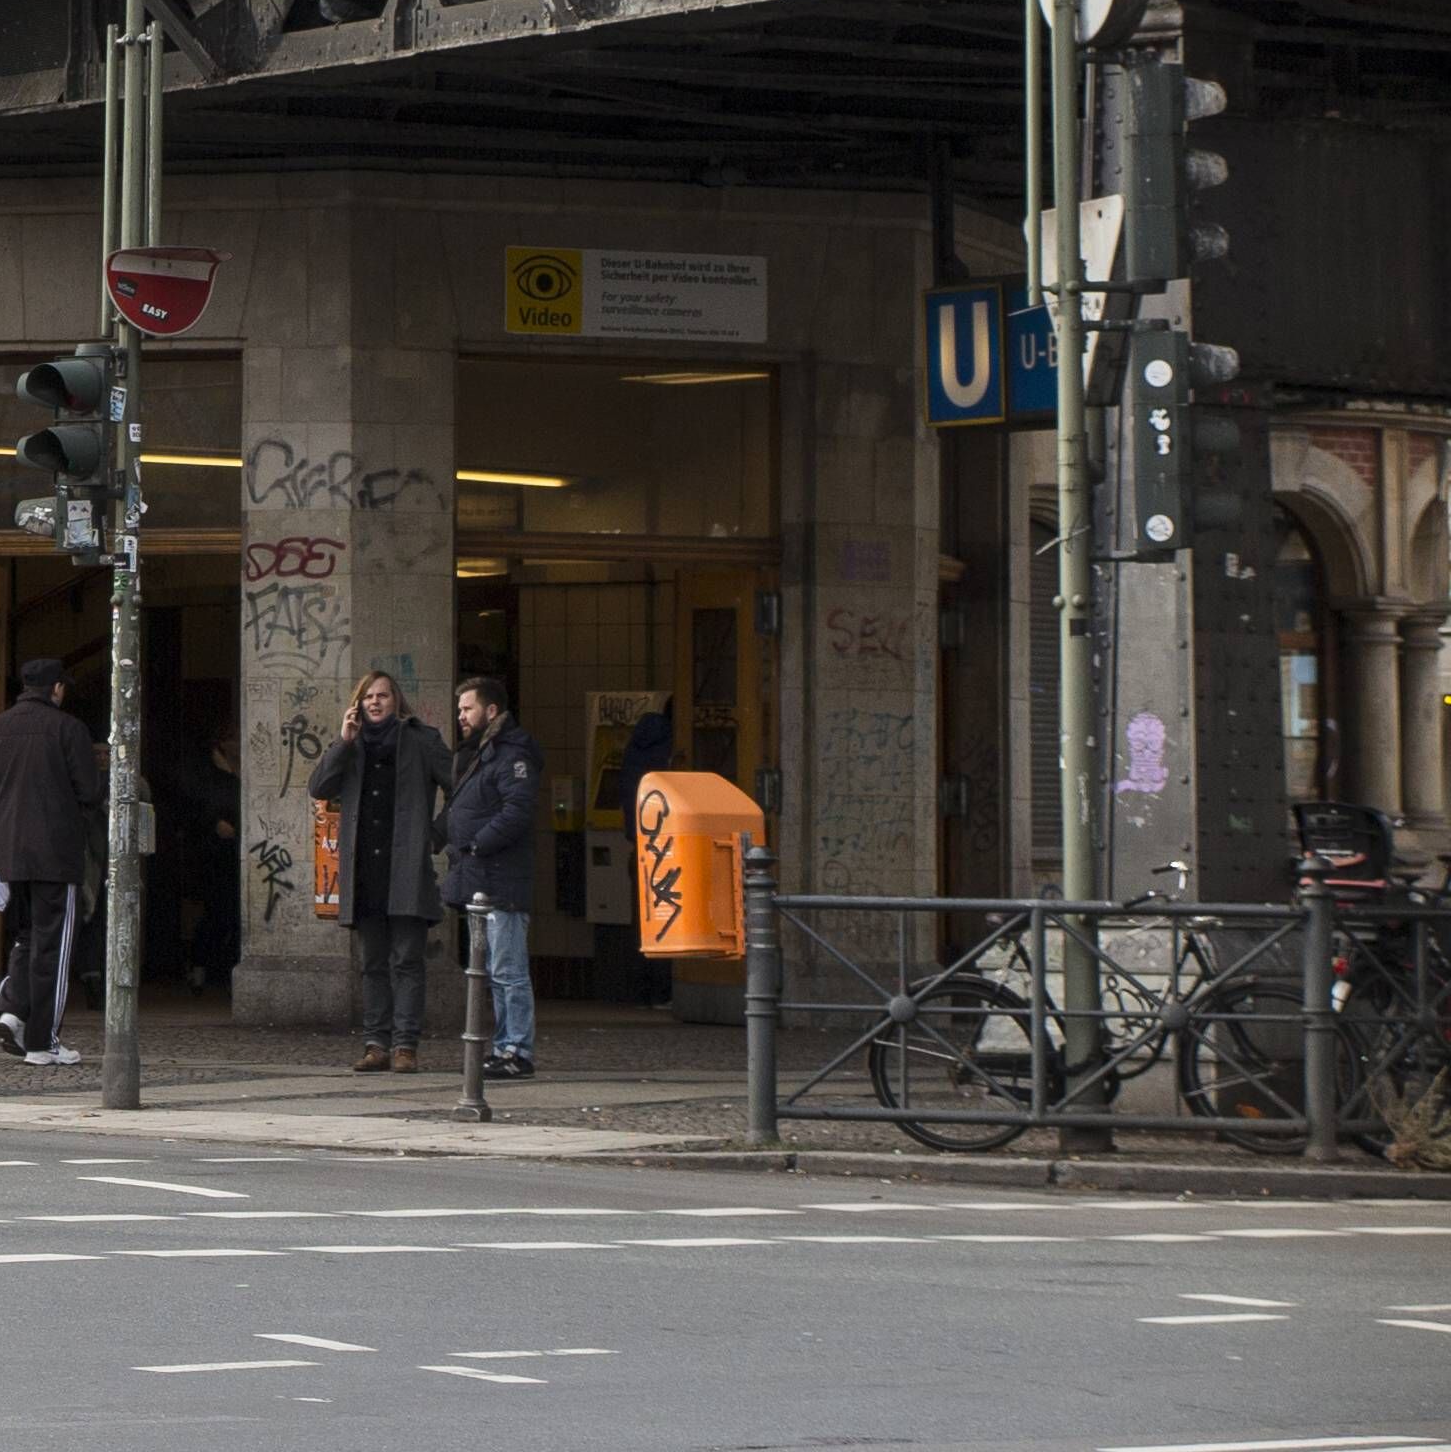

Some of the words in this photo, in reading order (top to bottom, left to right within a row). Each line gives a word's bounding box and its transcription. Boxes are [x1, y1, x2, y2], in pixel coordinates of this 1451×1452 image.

[601, 257, 631, 269] Dieser
[634, 259, 686, 271] U-Bahnhof
[601, 270, 650, 282] Sicherheit
[652, 274, 668, 285] per
[672, 274, 699, 284] Video
[601, 291, 618, 301] For
[619, 293, 643, 305] your
[142, 303, 168, 320] EASY
[519, 307, 572, 327] Video
[601, 305, 659, 317] surveillance
[661, 308, 702, 318] cameras
[939, 301, 990, 408] U
